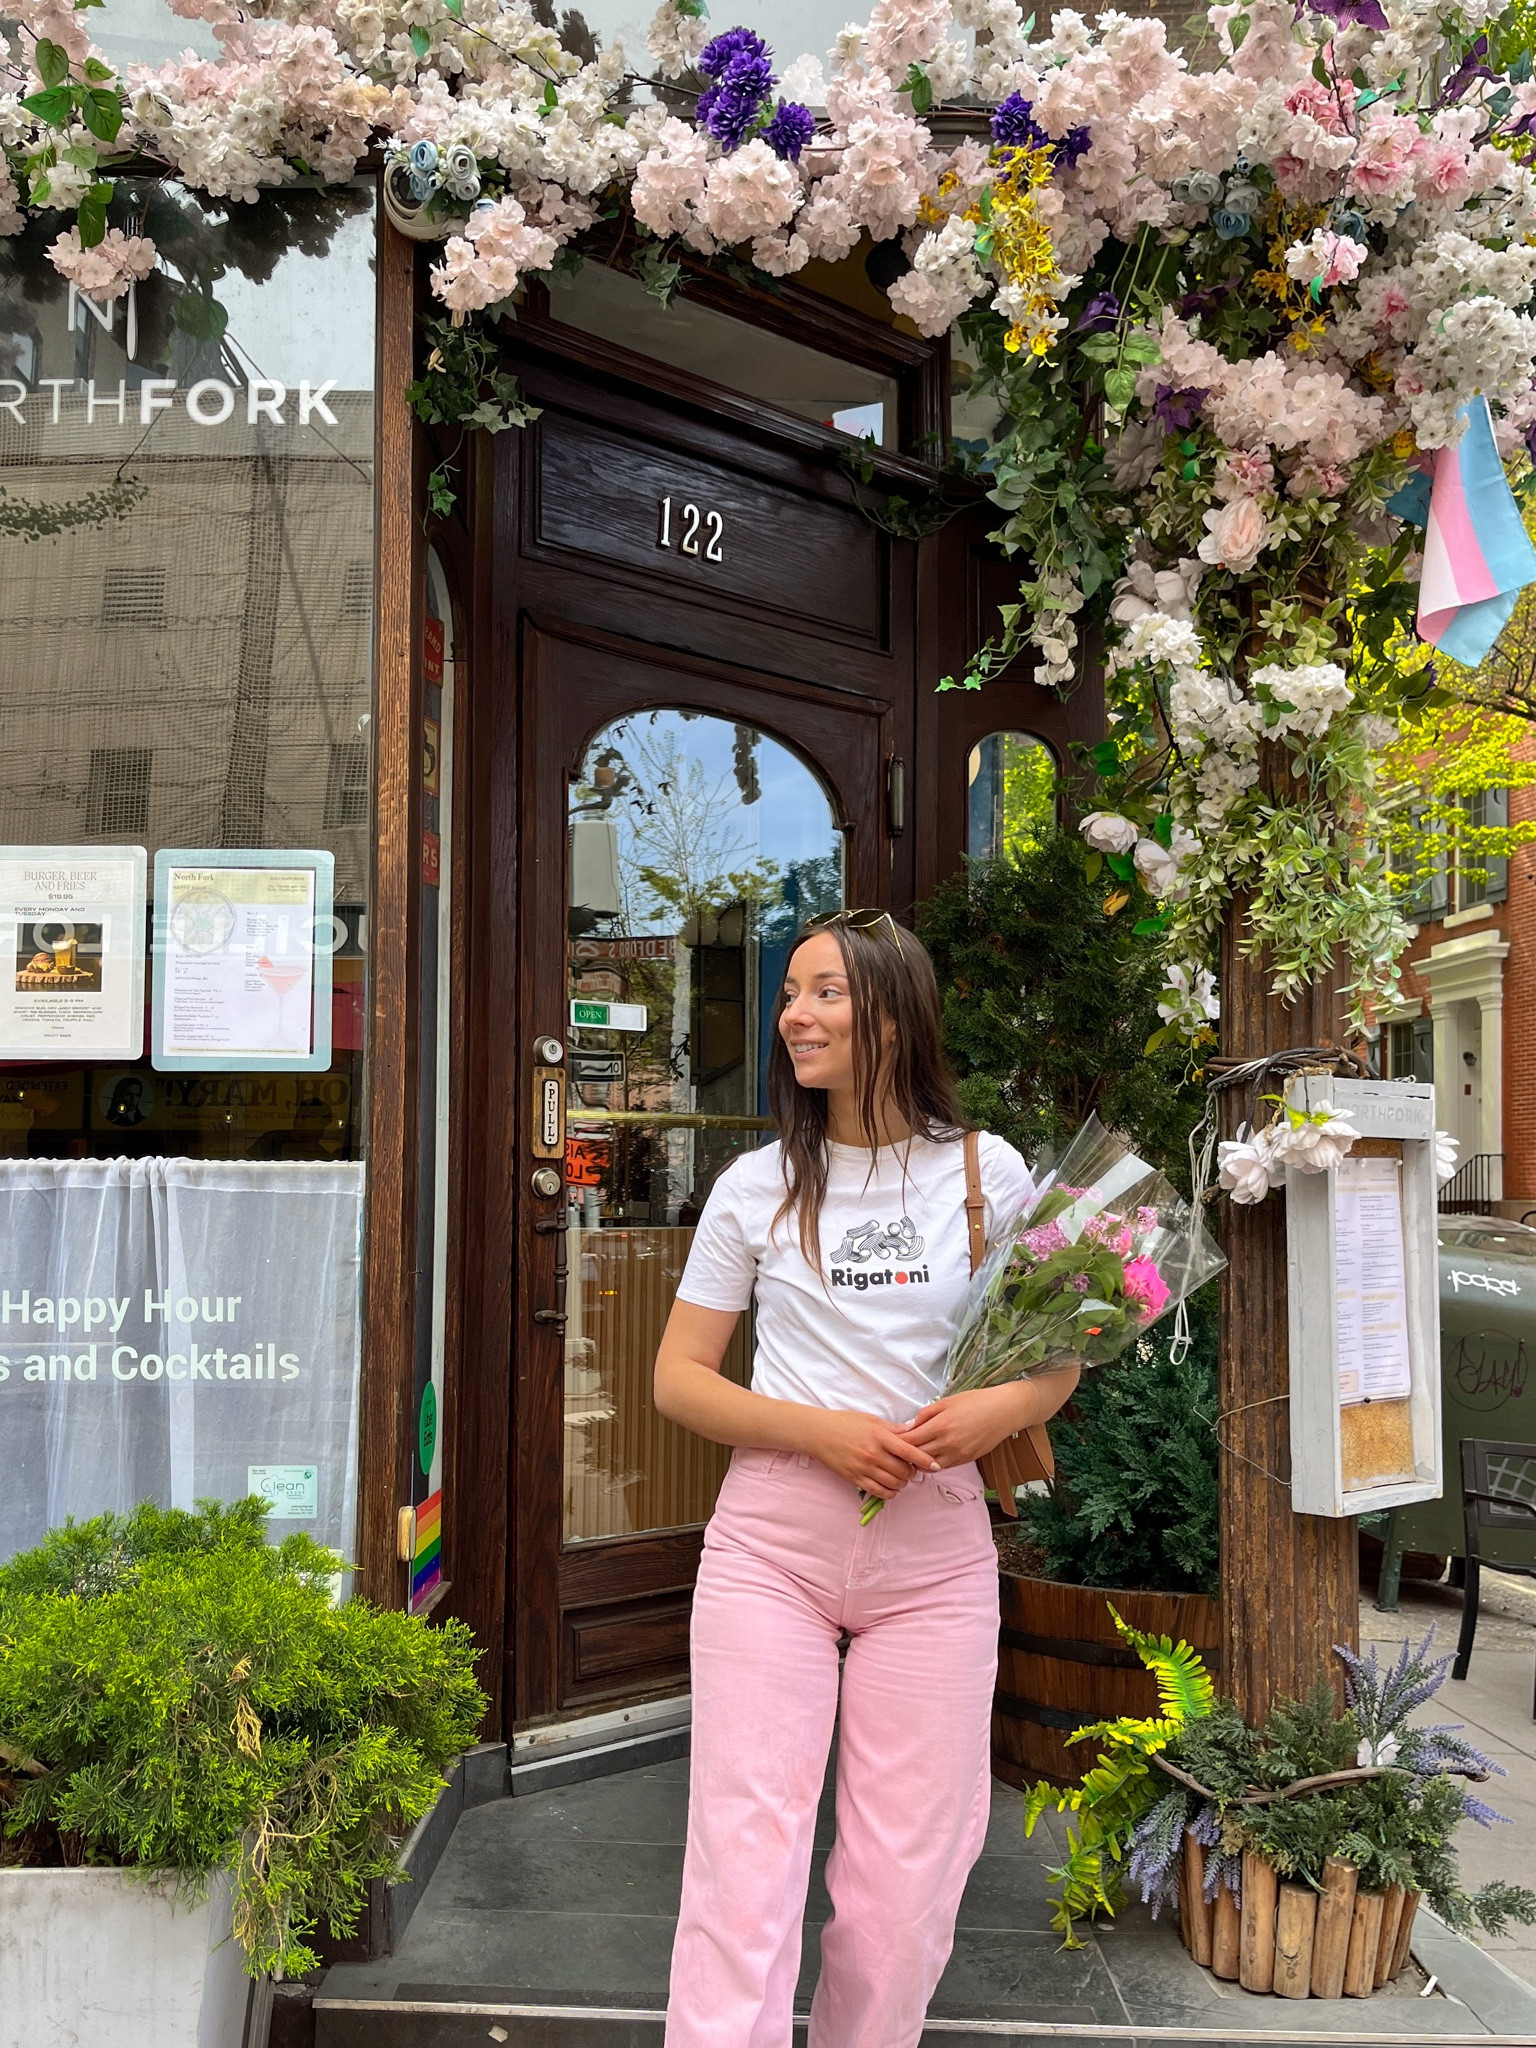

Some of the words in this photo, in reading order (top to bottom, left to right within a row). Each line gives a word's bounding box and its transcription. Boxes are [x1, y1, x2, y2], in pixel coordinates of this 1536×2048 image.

[659, 496, 724, 563] 122
[24, 870, 67, 882] BURGER,
[69, 871, 97, 881] BEER
[173, 872, 197, 882] North
[197, 872, 215, 882] Fork
[34, 881, 56, 891] AND
[56, 881, 86, 891] FRIES
[578, 1009, 603, 1020] OPEN
[547, 1087, 557, 1138] PULL
[830, 1264, 930, 1291] Rigatoni
[1, 1289, 131, 1333] Happy
[143, 1288, 242, 1323] Hour
[23, 1344, 97, 1381] and
[111, 1343, 300, 1382] Cocktails
[423, 1430, 434, 1448] Eats
[261, 1478, 305, 1493] Clean
